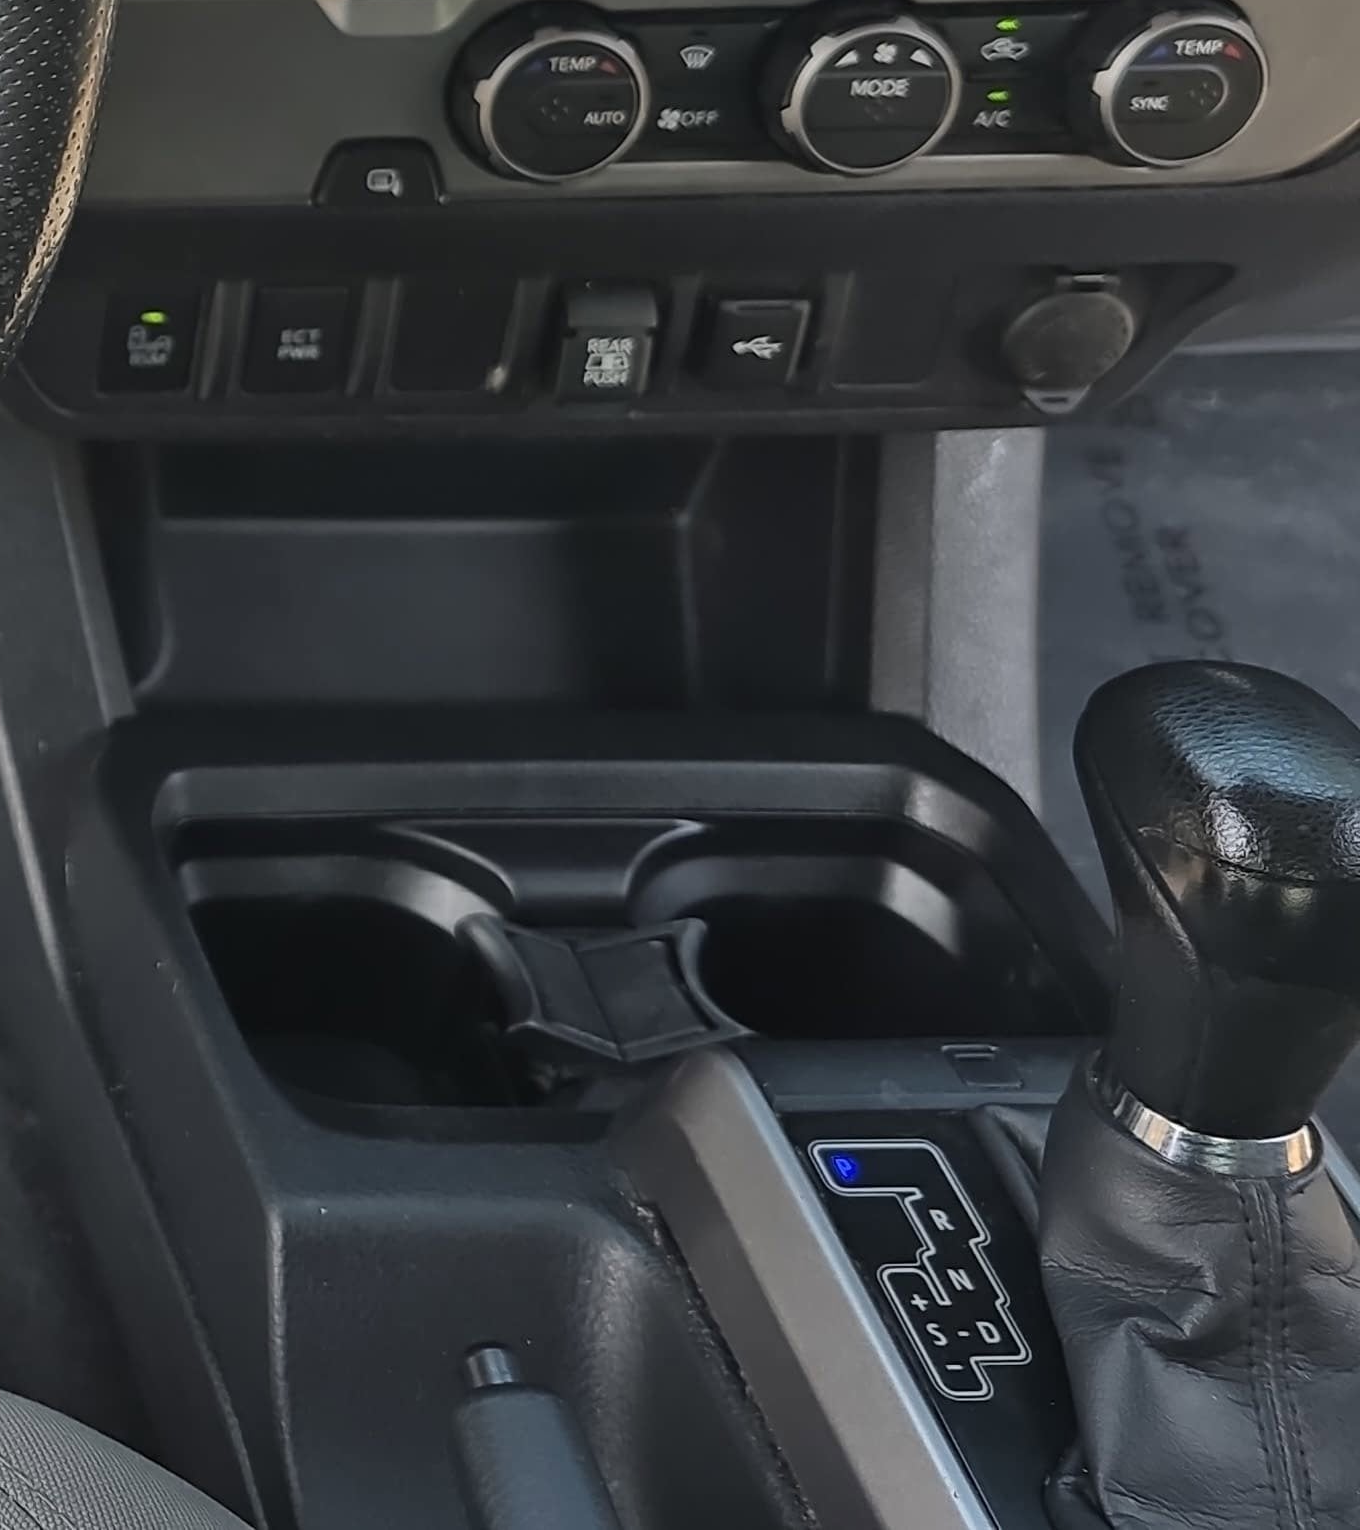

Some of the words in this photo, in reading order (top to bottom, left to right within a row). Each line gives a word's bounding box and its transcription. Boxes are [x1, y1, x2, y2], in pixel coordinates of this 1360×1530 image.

[1174, 39, 1222, 56] TEMP
[549, 56, 597, 72] TEMP
[850, 78, 910, 98] MODE
[1130, 96, 1169, 111] SYNC
[584, 110, 625, 125] AUTO
[681, 110, 718, 125] OFF
[973, 110, 1011, 128] A/C
[587, 337, 632, 353] REAR
[583, 371, 629, 387] PUSH
[928, 1209, 955, 1230] R
[946, 1269, 975, 1290] N
[926, 1323, 948, 1346] S
[976, 1321, 1002, 1344] D
